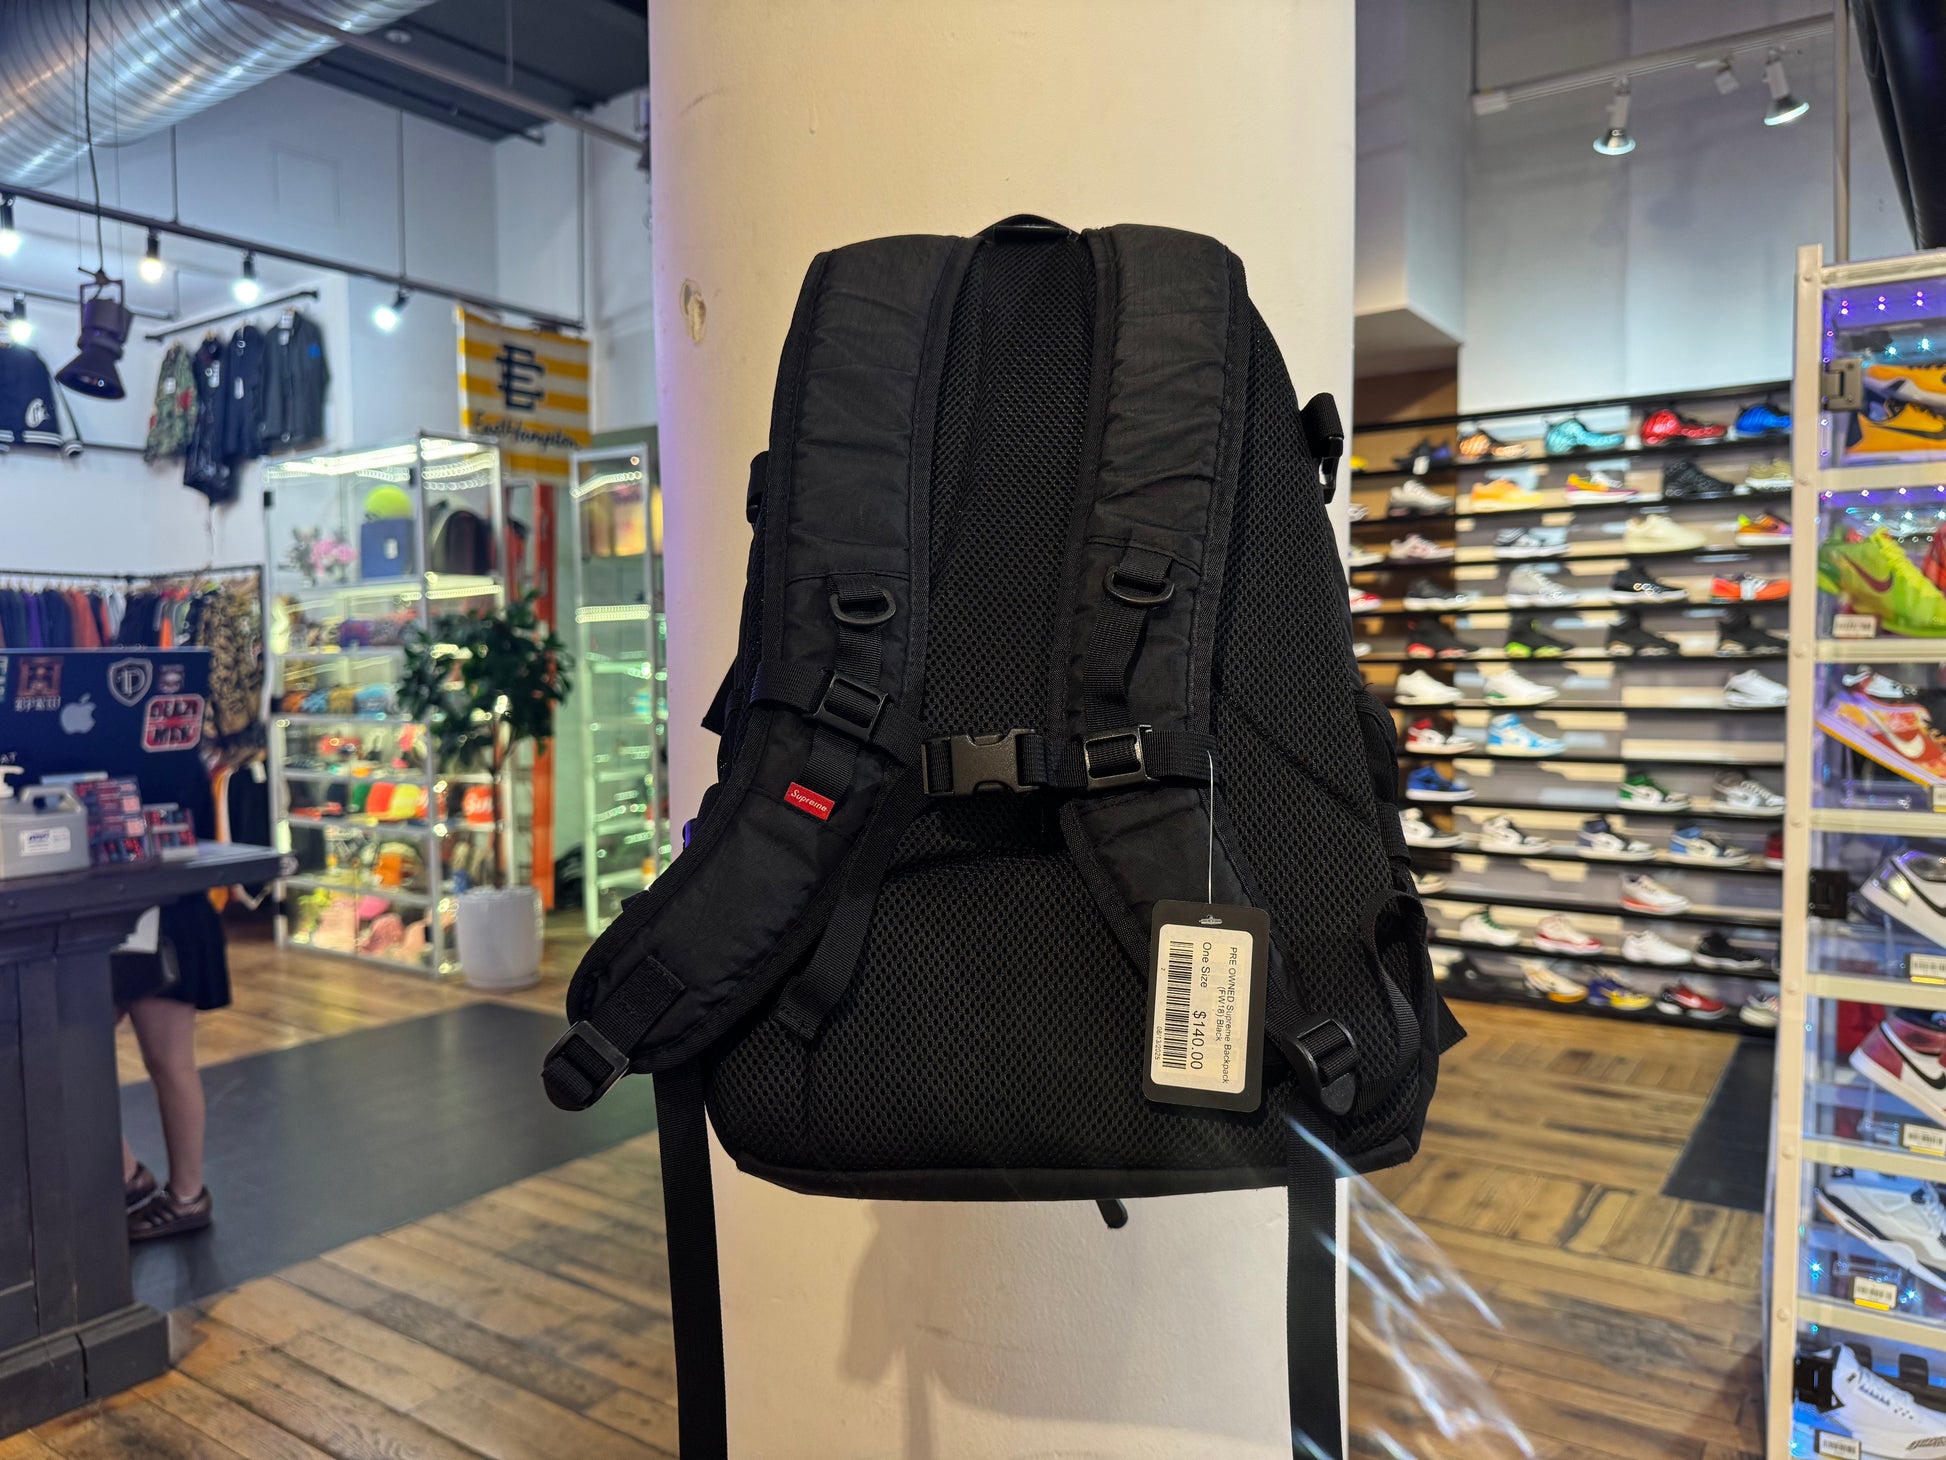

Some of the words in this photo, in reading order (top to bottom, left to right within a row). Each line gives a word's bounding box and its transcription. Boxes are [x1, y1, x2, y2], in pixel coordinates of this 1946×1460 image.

[790, 789, 828, 812] Supreme
[1201, 941, 1212, 963] One
[1228, 946, 1238, 966] PRE
[1200, 966, 1211, 988] Size
[1226, 968, 1237, 1003] OWNED
[1215, 986, 1227, 1018] (FW18)
[1215, 1019, 1225, 1042] Black
[1224, 1004, 1235, 1043] Supreme
[1190, 1010, 1207, 1070] $140.00
[1221, 1044, 1232, 1085] Backpack
